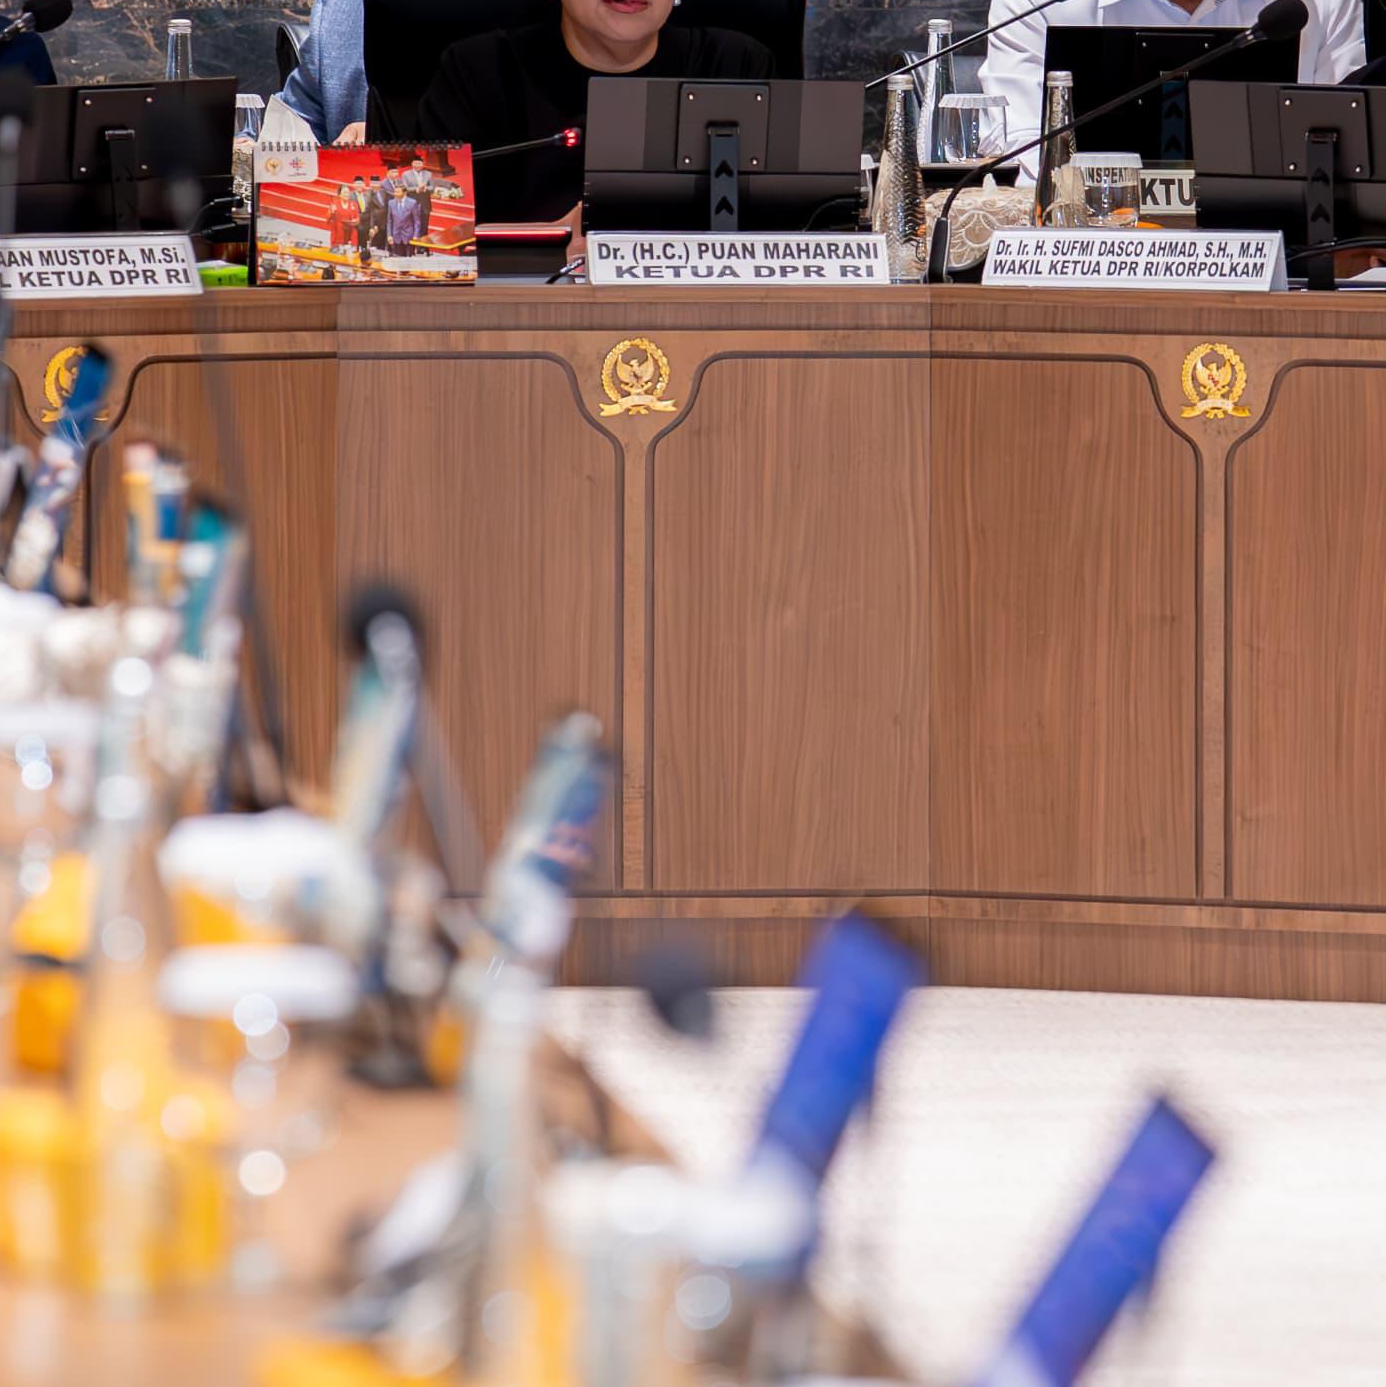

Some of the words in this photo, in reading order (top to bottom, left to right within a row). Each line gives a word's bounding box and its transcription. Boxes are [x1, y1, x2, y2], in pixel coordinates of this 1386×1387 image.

[38, 247, 136, 268] MUSTOFA,
[140, 246, 186, 264] M.Si.
[597, 243, 625, 260] Dr.
[632, 242, 690, 264] (H.C.)
[698, 243, 756, 260] PUAN
[763, 243, 879, 260] MAHARANI
[996, 240, 1013, 256] Dr.
[1017, 240, 1029, 256] Ir.
[1034, 240, 1048, 256] H.
[1051, 240, 1095, 257] SUFMI
[1098, 241, 1144, 257] DASCO
[1146, 241, 1199, 261] AHMAD,
[1204, 242, 1234, 262] S.H.,
[1238, 242, 1267, 259] M.H.
[19, 270, 103, 288] KETUA
[109, 269, 159, 286] DPR
[166, 268, 192, 284] RI
[615, 265, 741, 278] KETUA
[754, 265, 827, 278] DPR
[839, 265, 874, 278] RI
[992, 259, 1043, 275] WAKIL
[1048, 260, 1101, 276] KETUA
[1106, 261, 1139, 276] DPR
[1143, 261, 1265, 278] RI/KORPOLKAM
